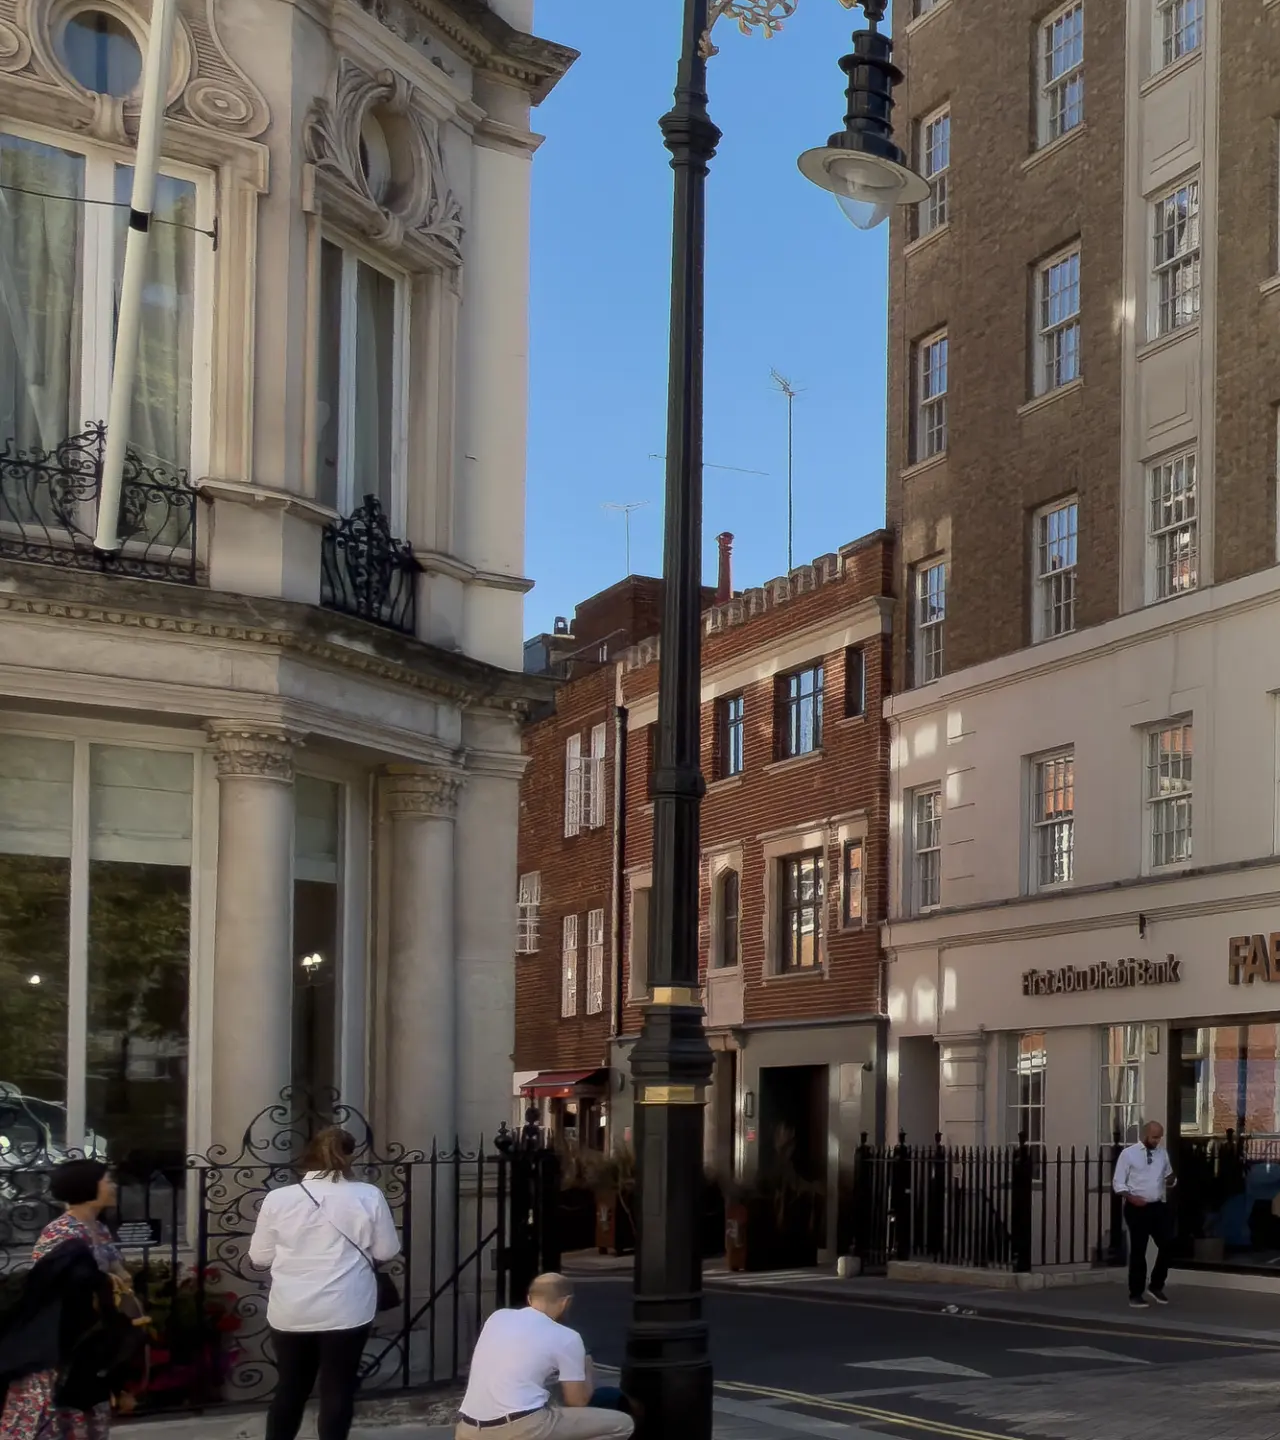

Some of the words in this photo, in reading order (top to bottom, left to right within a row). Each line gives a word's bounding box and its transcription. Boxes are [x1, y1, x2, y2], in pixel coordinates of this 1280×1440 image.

[1022, 968, 1054, 996] First
[1053, 964, 1087, 993] Abu
[1086, 958, 1135, 990] Dhabi
[1134, 953, 1181, 985] Bank
